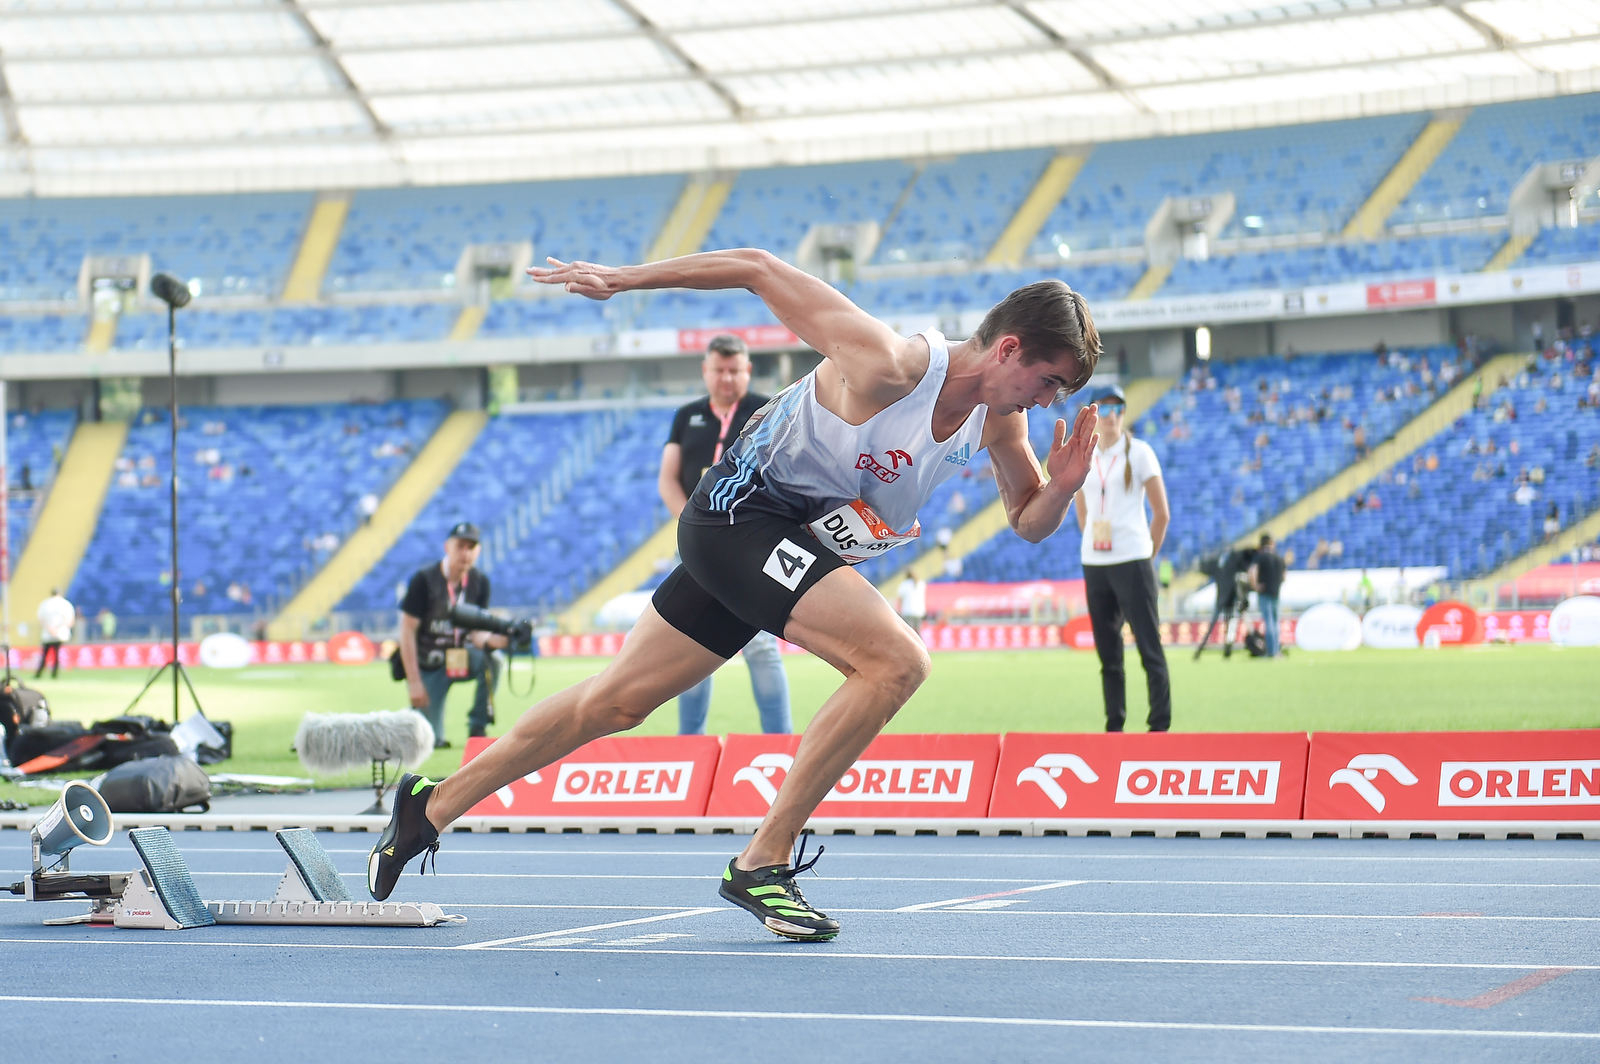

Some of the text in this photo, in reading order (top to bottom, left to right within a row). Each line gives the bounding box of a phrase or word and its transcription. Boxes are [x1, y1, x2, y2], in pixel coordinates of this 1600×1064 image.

[776, 548, 806, 579] 4
[564, 768, 683, 796] ORLEN
[834, 767, 962, 794] ORLEN
[1126, 768, 1268, 796] ORLEN
[1449, 768, 1600, 798] ORLEN
